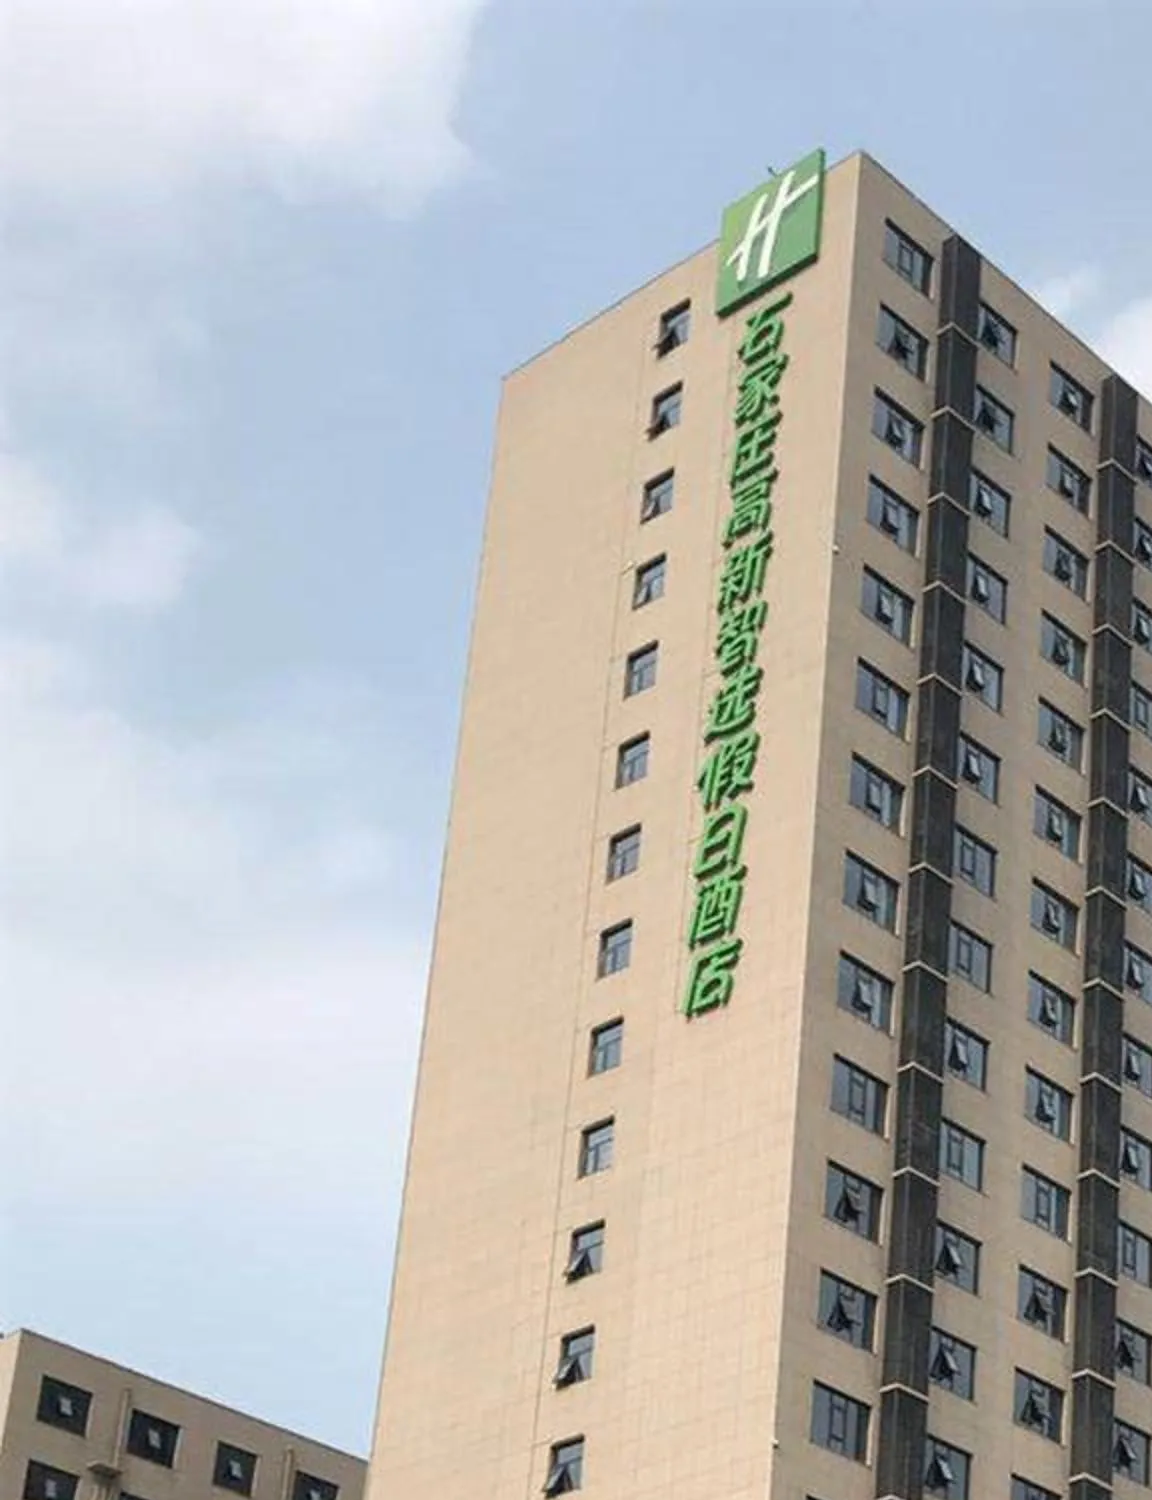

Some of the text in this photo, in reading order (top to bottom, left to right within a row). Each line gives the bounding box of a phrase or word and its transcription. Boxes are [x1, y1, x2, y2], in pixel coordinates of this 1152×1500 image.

[681, 291, 794, 1023] 石家庄高新智选假日酒店
